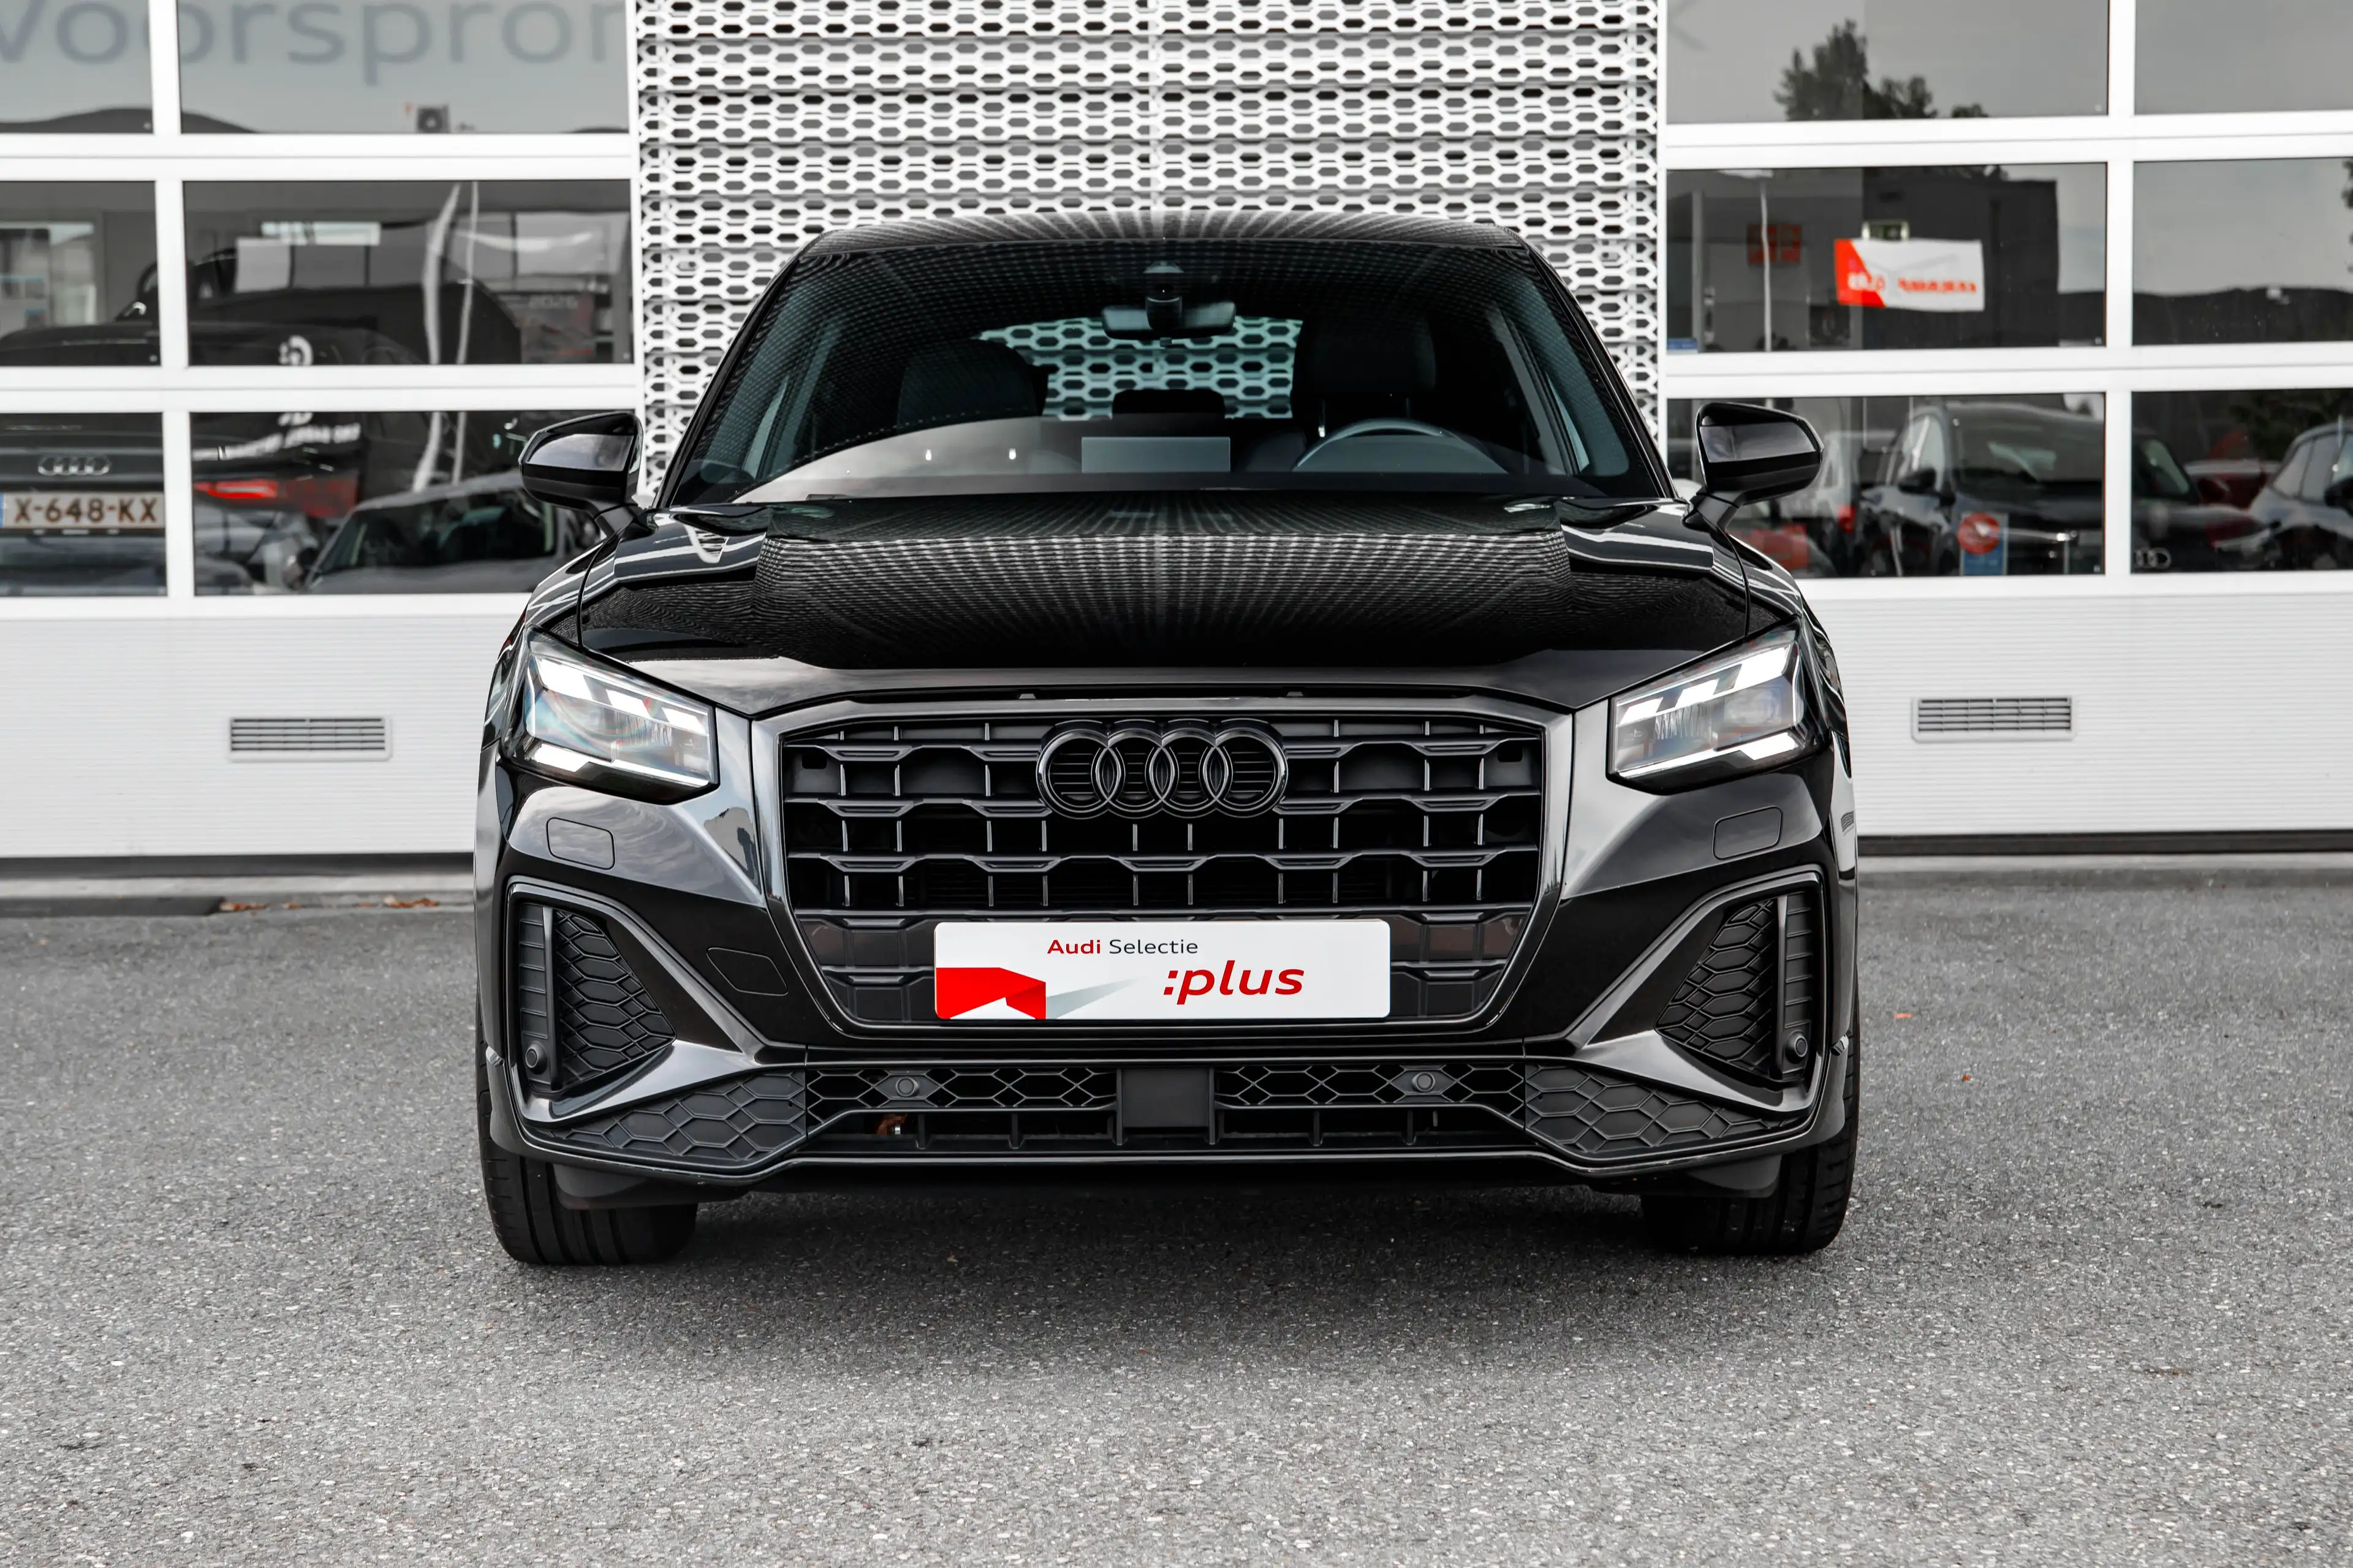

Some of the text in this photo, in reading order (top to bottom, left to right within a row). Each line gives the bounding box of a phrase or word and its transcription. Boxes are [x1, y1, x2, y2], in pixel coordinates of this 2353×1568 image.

[15, 498, 157, 524] X-648-KX
[1047, 939, 1199, 955] Audi Selectie
[1163, 960, 1305, 1006] :plus
